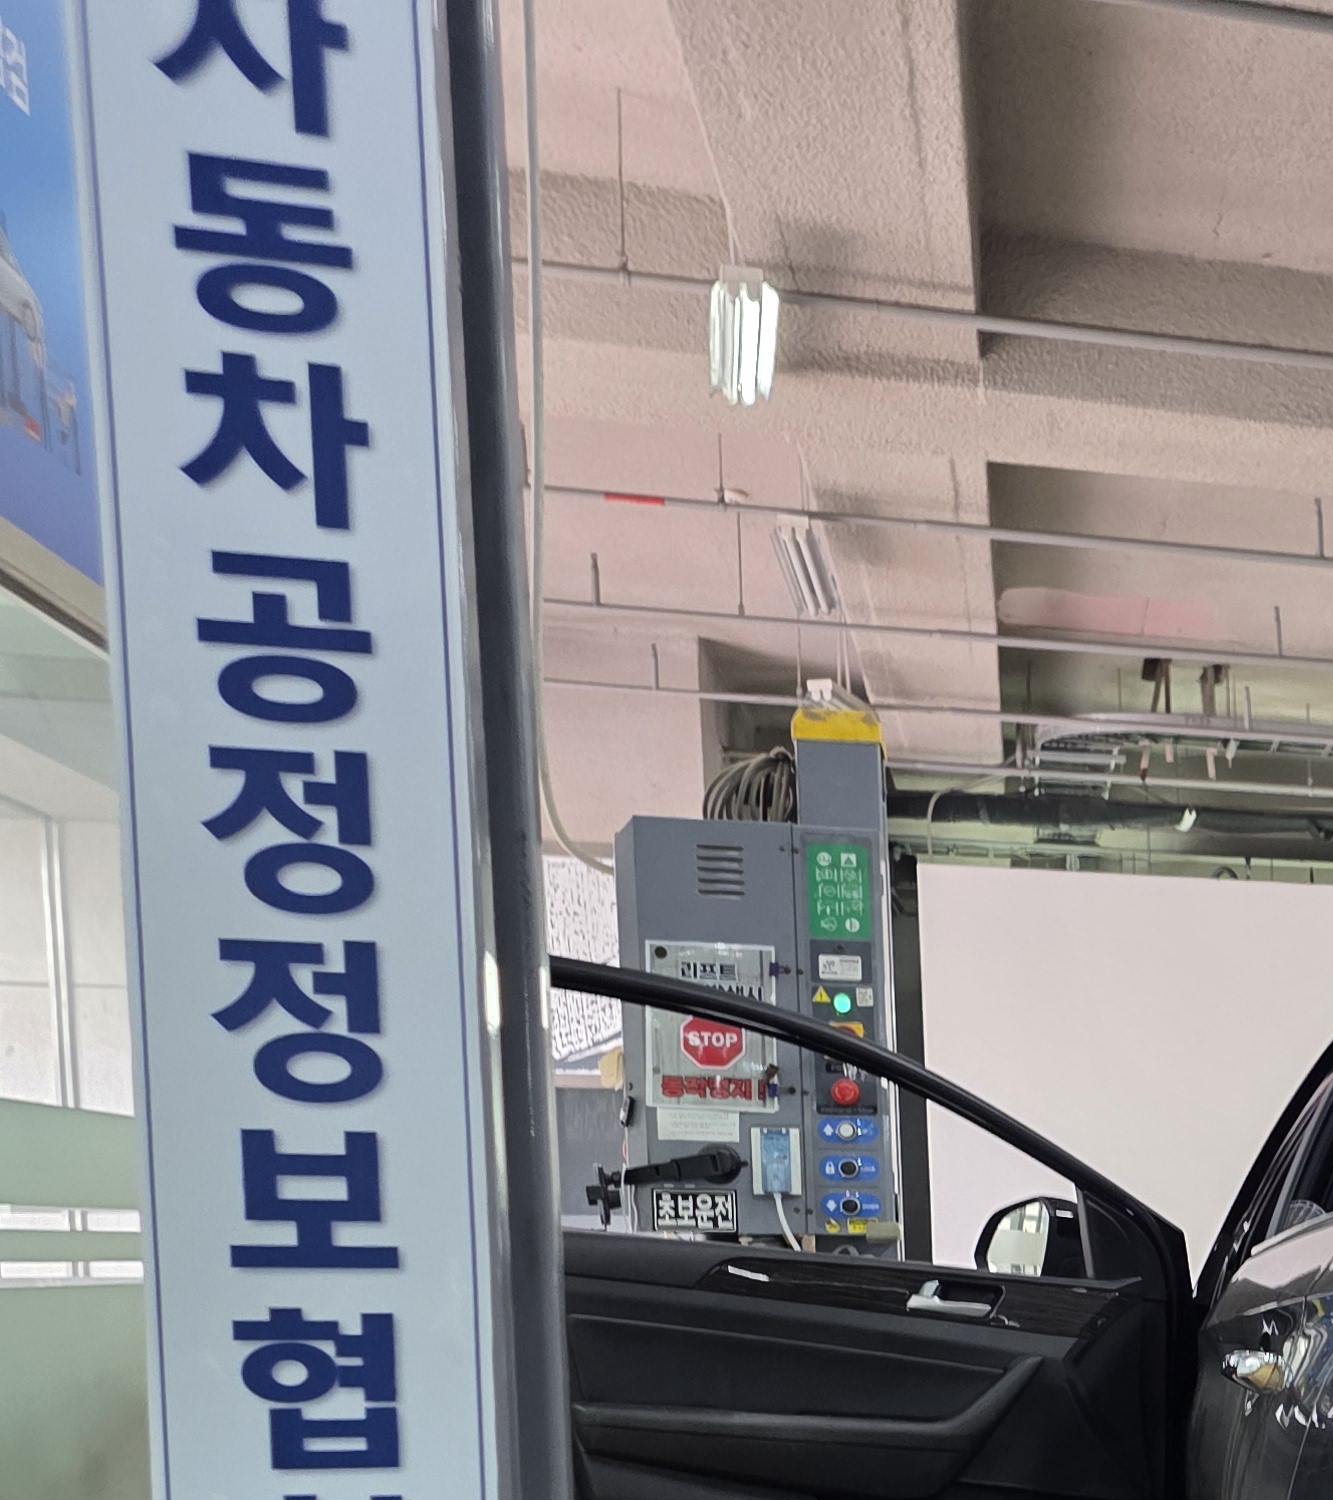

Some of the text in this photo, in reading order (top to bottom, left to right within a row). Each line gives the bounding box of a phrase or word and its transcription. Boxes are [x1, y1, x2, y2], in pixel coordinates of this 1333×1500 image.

[681, 961, 737, 981] 리프트
[687, 1031, 738, 1048] STOP
[658, 1192, 734, 1230] 초보운전
